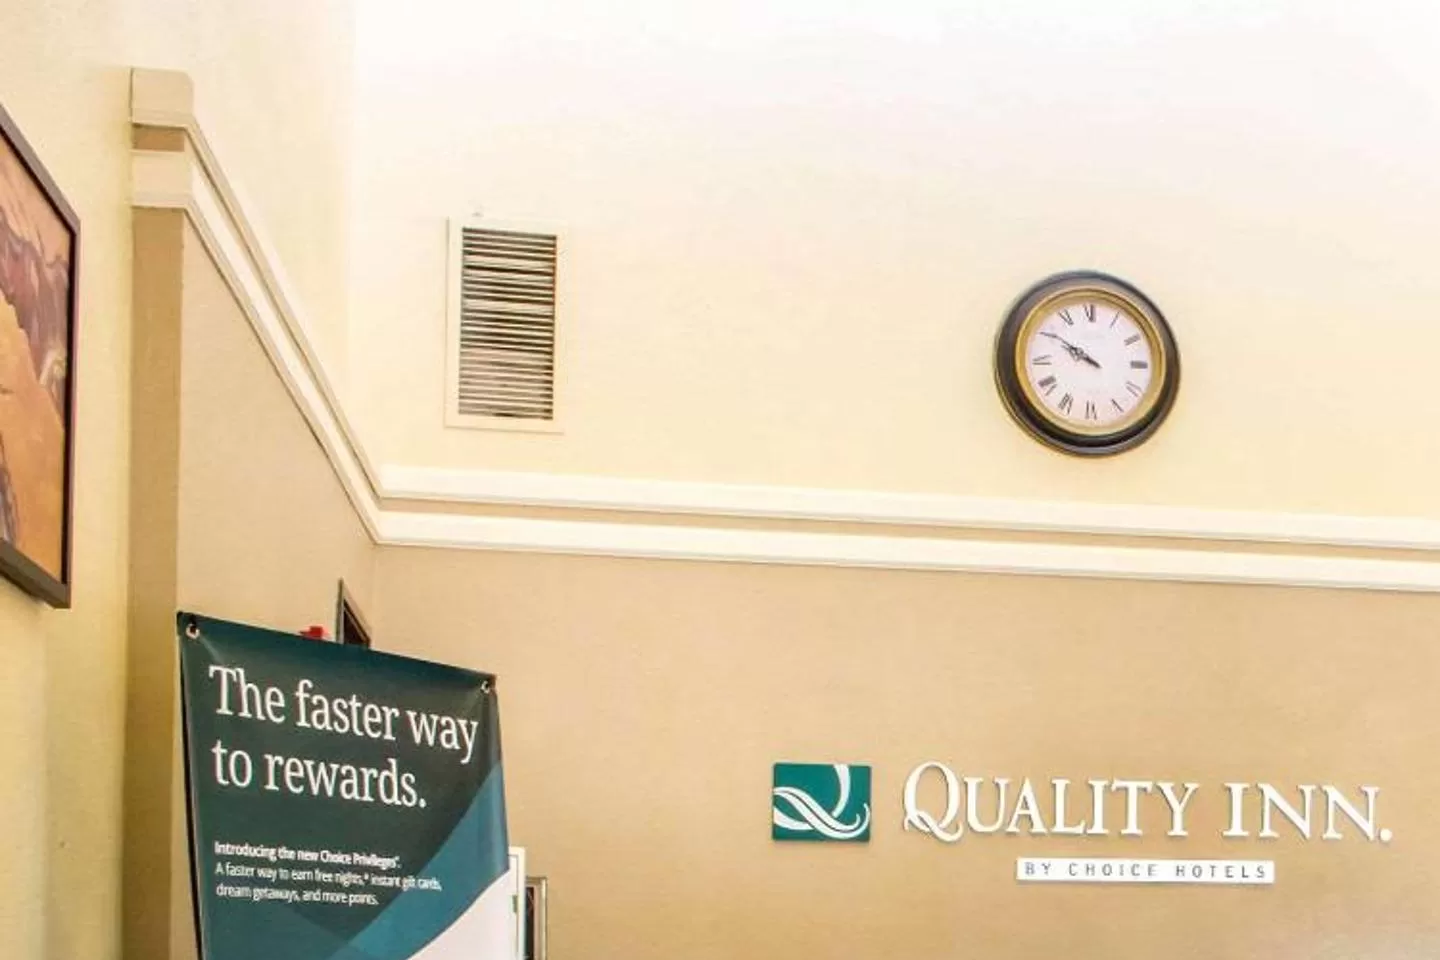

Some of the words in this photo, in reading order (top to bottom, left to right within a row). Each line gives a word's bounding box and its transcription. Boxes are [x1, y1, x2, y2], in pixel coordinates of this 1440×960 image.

[208, 665, 286, 725] The
[295, 679, 400, 741] faster
[406, 710, 479, 764] way
[210, 739, 252, 788] to
[264, 754, 427, 808] rewards.
[903, 761, 1200, 843] QUALITY
[1222, 782, 1393, 842] INN.
[214, 841, 278, 862] Introducing
[278, 846, 296, 860] the
[297, 849, 319, 861] new
[320, 849, 352, 865] Choice
[215, 861, 225, 875] A
[225, 862, 255, 877] faster
[256, 868, 277, 883] way
[278, 868, 290, 880] to
[291, 869, 314, 881] earn
[314, 868, 333, 882] free
[371, 873, 402, 887] instant
[1024, 861, 1052, 875] BY
[1068, 862, 1158, 877] CHOICE
[1175, 865, 1266, 879] HOTELS
[216, 883, 252, 898] dream
[302, 889, 321, 902] and
[322, 891, 348, 903] more
